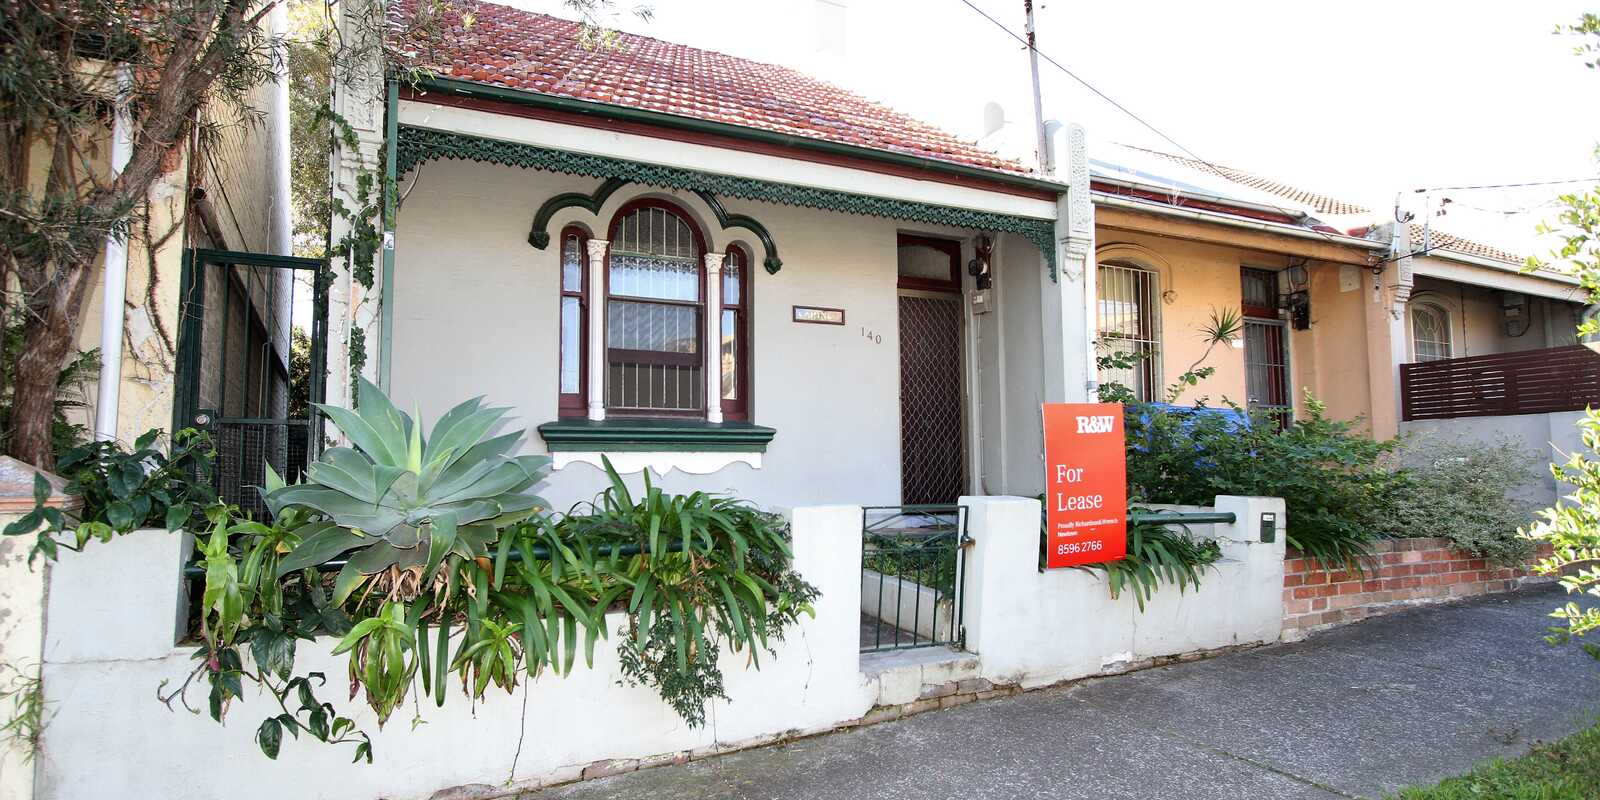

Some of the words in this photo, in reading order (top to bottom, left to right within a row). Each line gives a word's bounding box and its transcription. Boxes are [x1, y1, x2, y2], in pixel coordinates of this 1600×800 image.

[861, 326, 882, 344] 140
[1075, 415, 1115, 434] R&W
[1056, 464, 1083, 484] For
[1057, 492, 1103, 512] Lease
[1057, 543, 1080, 555] 8596
[1081, 540, 1103, 552] 2766
